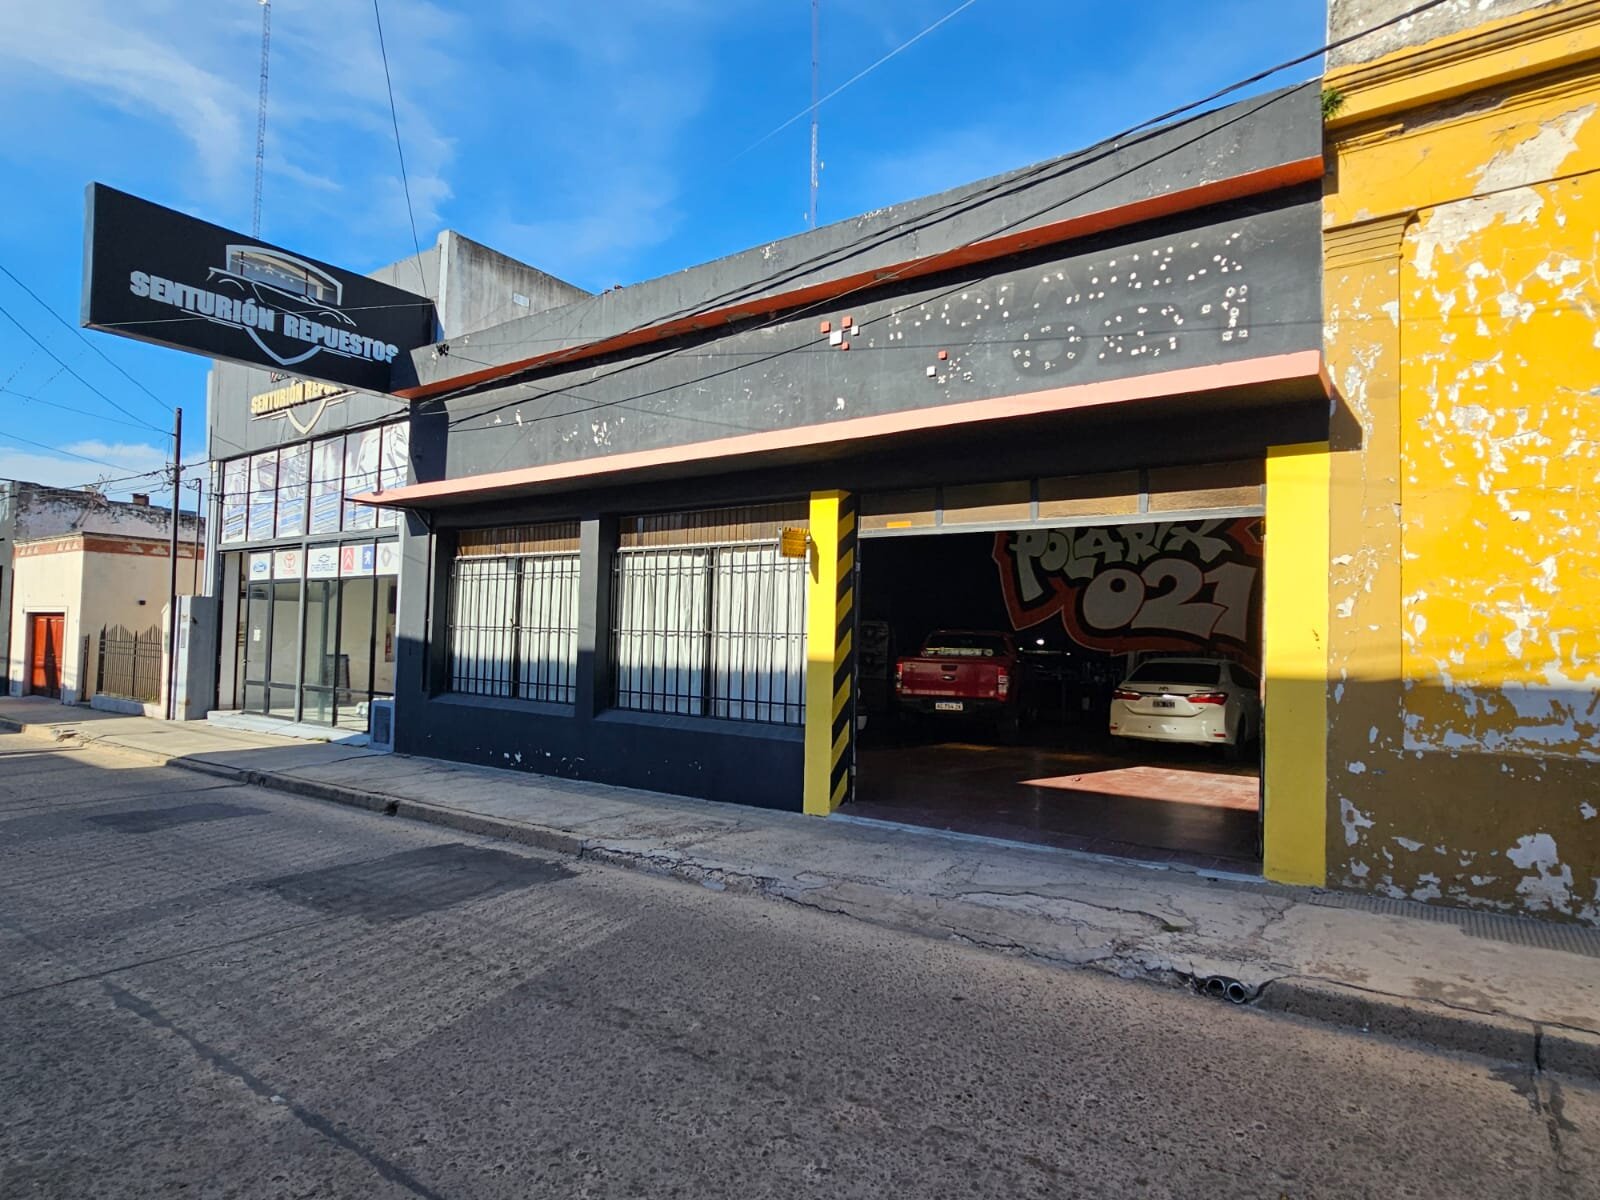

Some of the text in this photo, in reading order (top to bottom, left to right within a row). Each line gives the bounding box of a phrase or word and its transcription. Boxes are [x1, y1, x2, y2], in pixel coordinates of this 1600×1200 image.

[130, 270, 399, 364] SENTURIÓN REPUESTOS
[1083, 557, 1257, 642] 021
